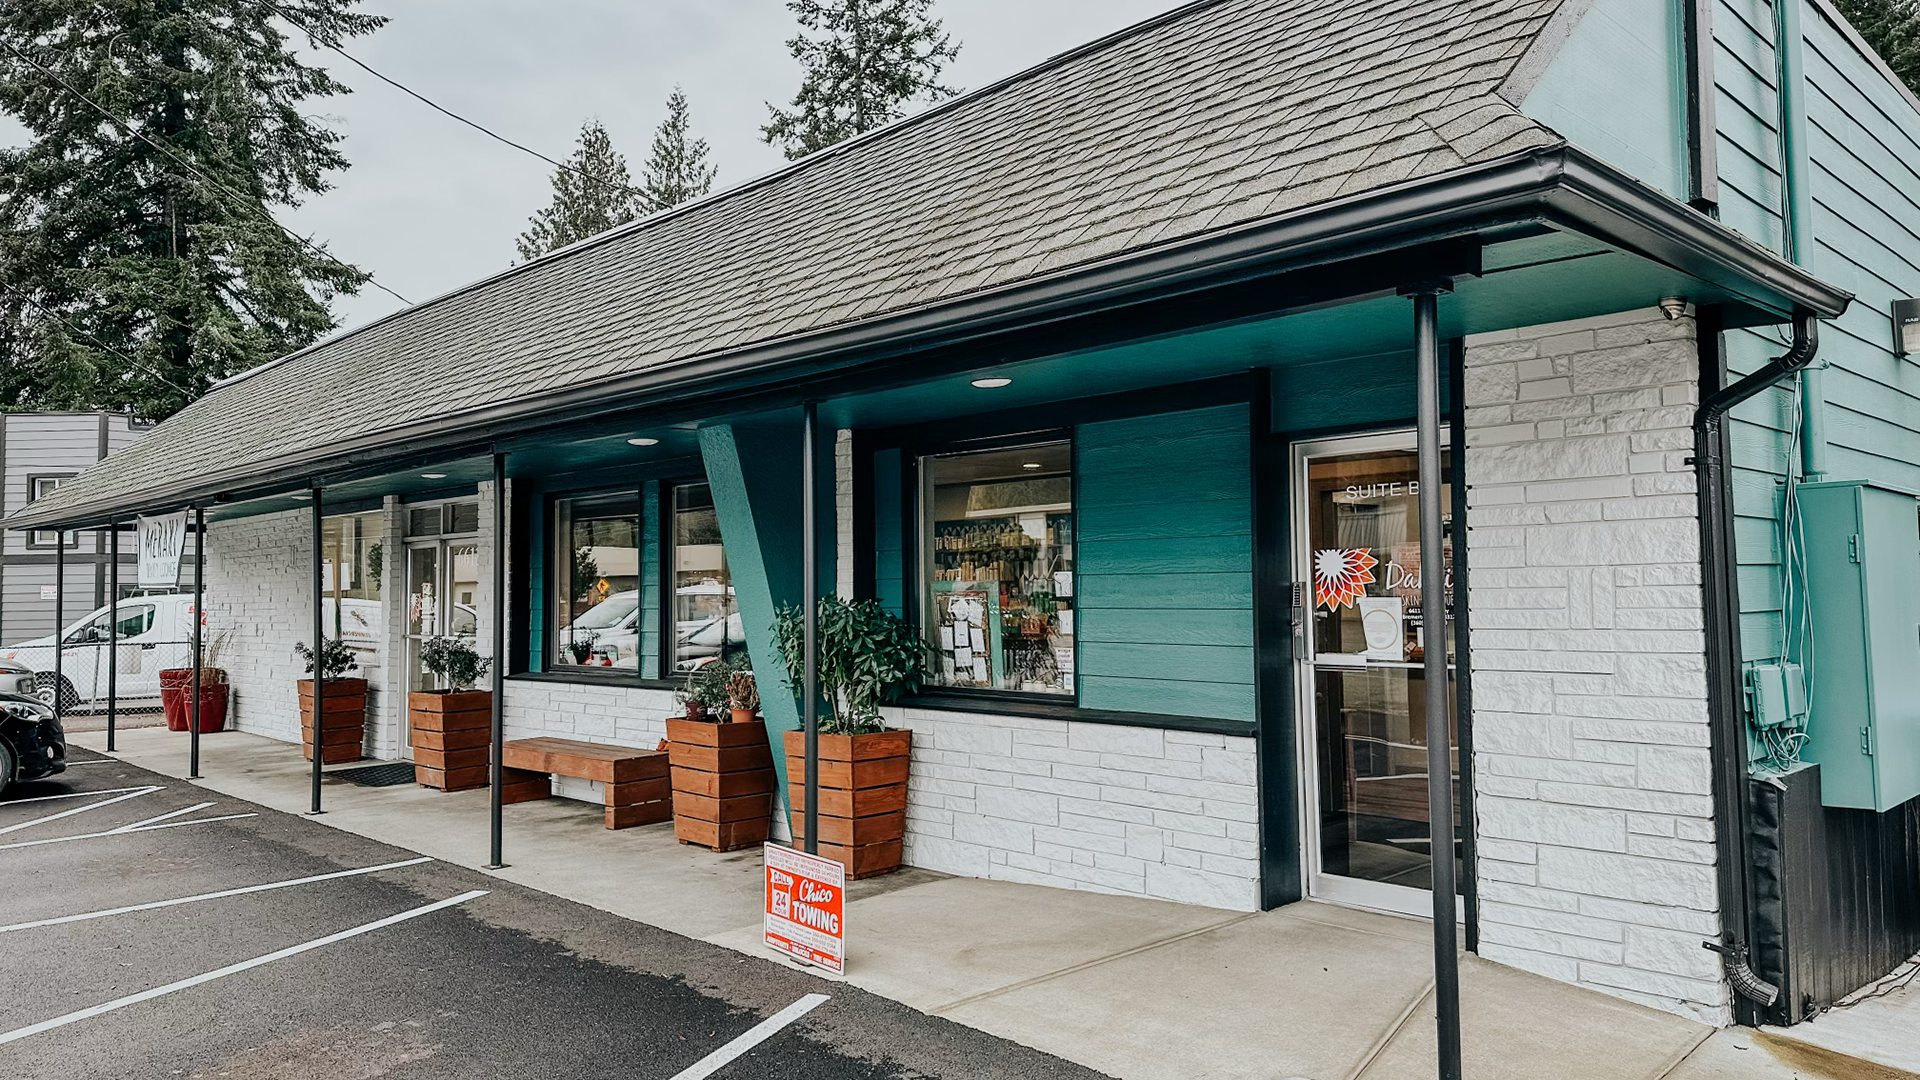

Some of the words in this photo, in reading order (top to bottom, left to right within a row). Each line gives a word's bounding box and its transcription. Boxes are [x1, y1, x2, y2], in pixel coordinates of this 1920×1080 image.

[1346, 482, 1402, 499] SUITE
[1408, 481, 1420, 495] B
[1402, 594, 1420, 606] SKIN
[773, 872, 790, 884] CALL
[799, 878, 834, 903] Chico
[775, 892, 786, 908] 24
[774, 906, 788, 916] HOUR
[792, 900, 838, 934] TOWING
